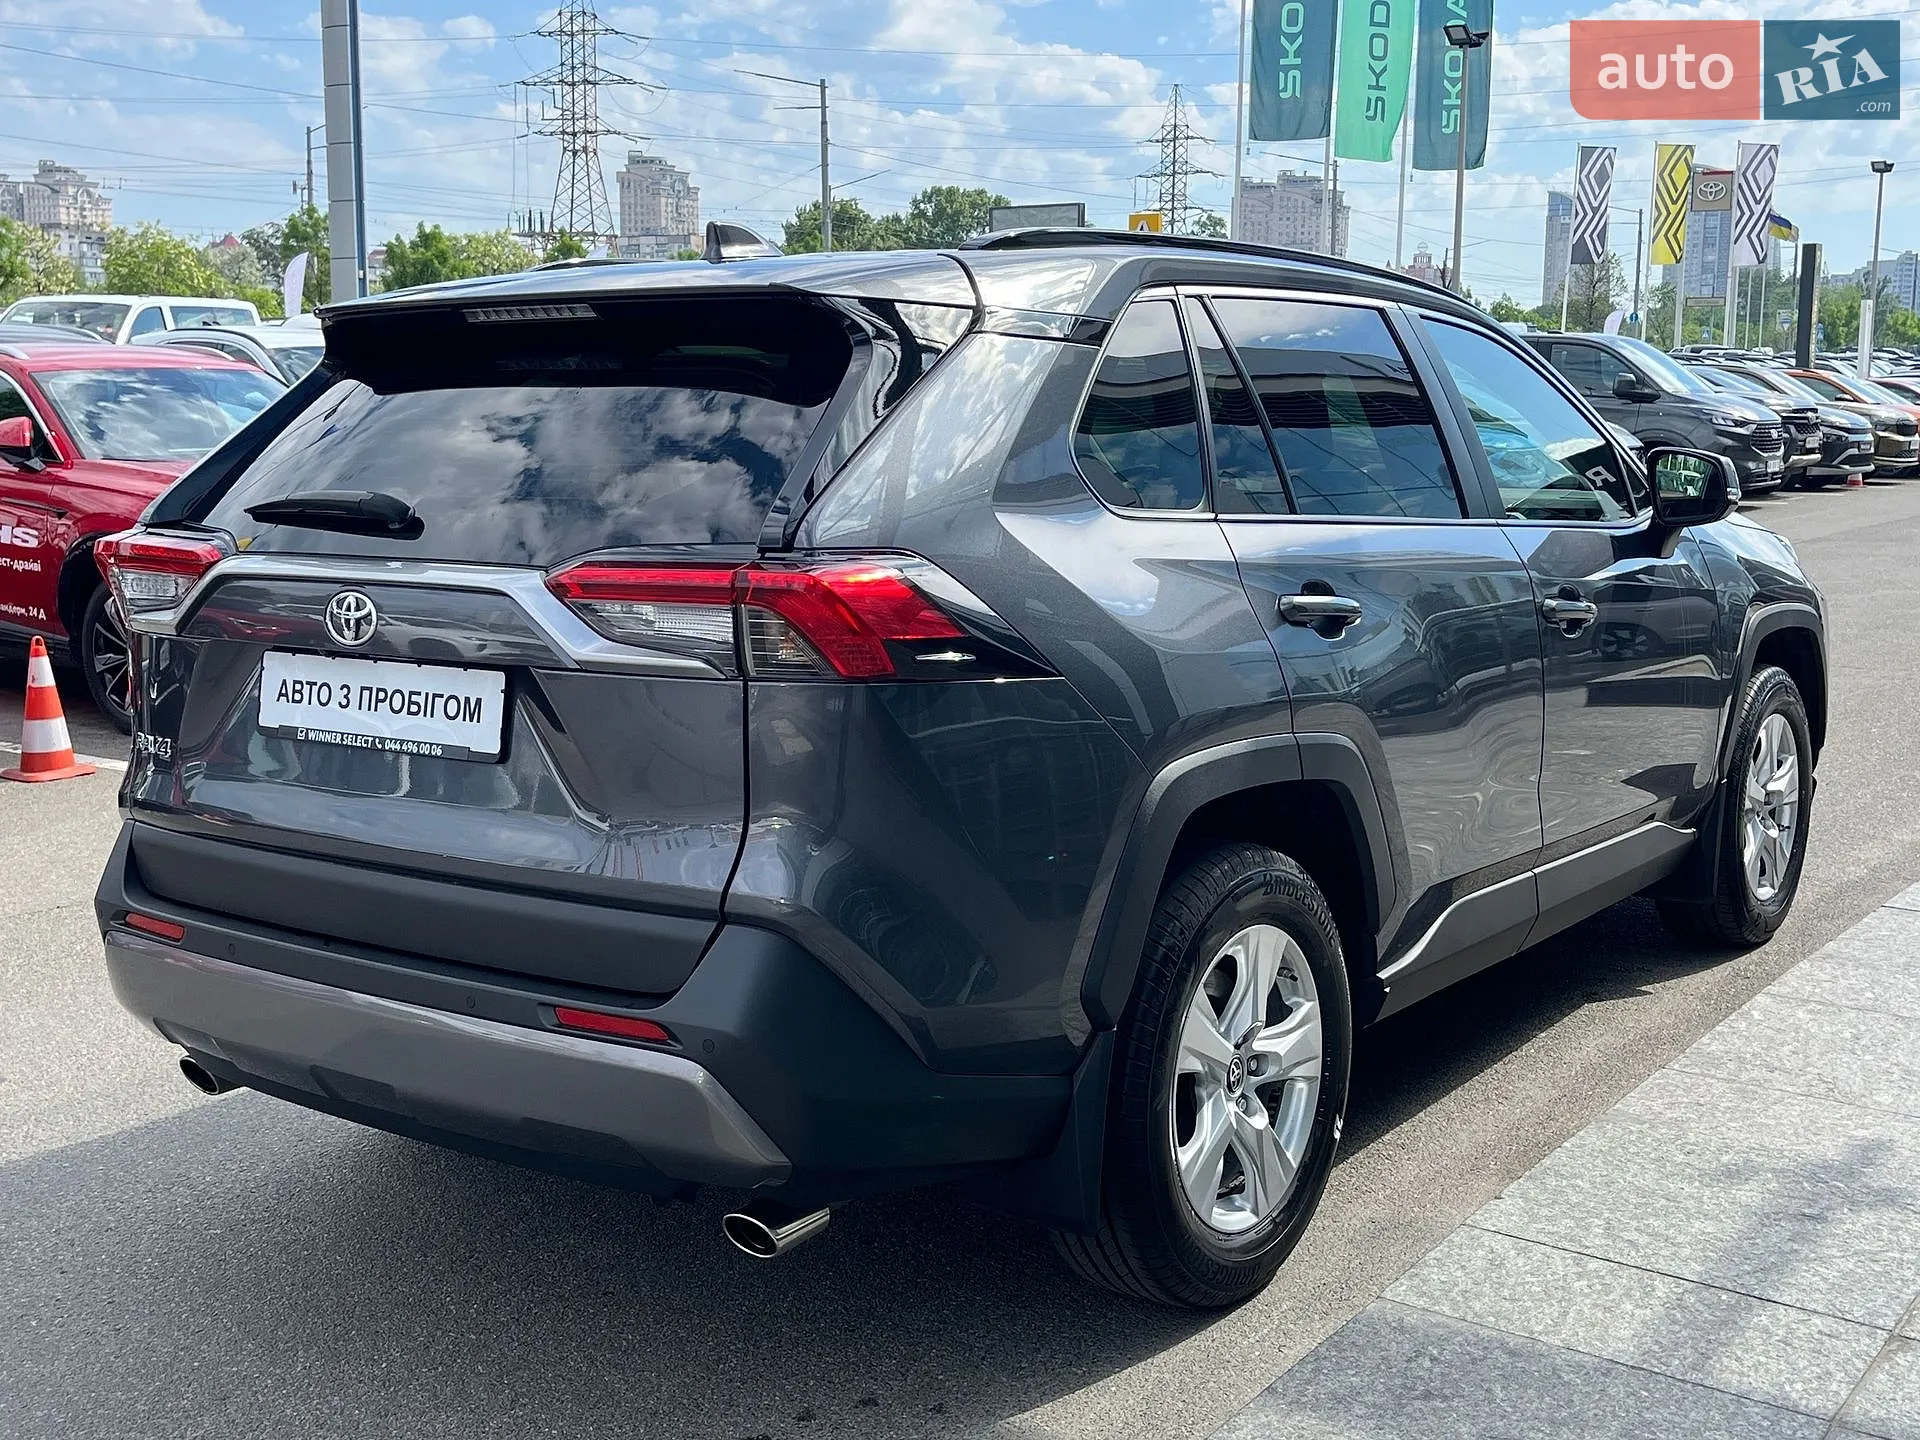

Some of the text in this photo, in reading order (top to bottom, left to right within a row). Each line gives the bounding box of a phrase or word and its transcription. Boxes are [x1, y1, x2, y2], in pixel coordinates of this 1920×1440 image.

[276, 678, 332, 707] АВТО
[358, 685, 483, 724] ПРОБІГОМ
[308, 729, 442, 756] WINNER SELECT 044 496 00 06
